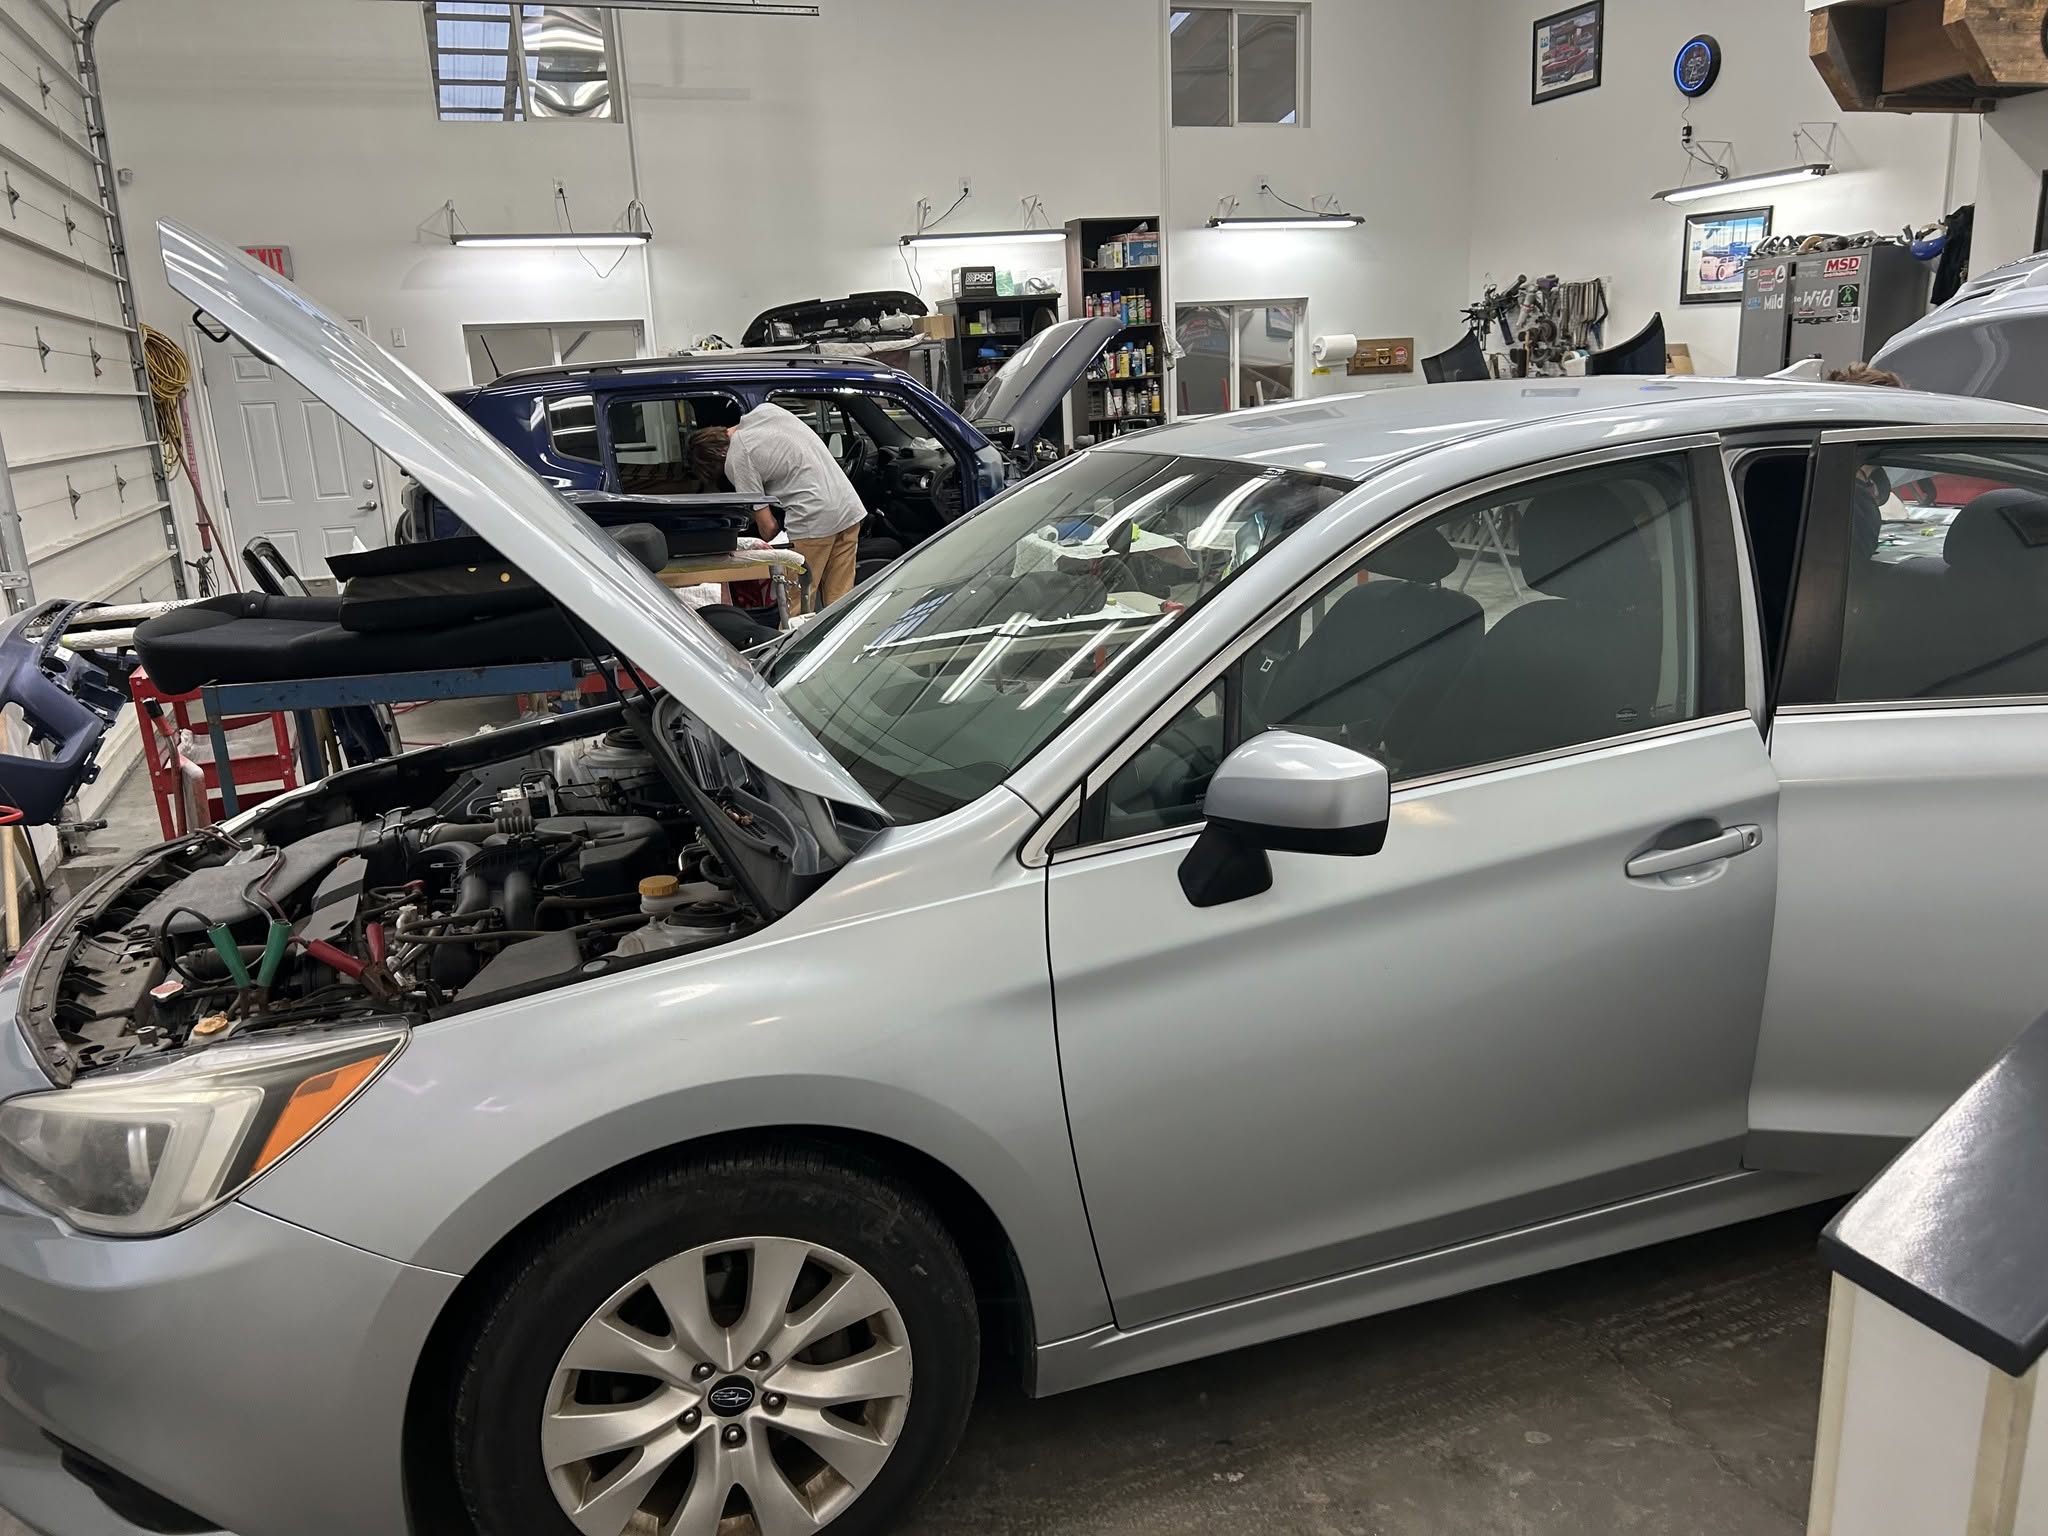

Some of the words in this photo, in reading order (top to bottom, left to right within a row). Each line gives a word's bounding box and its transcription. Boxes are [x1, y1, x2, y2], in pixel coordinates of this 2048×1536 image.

[246, 248, 284, 276] XIT
[1826, 258, 1859, 271] MSD
[973, 273, 992, 282] PSC
[1763, 293, 1784, 310] Mild
[1793, 295, 1802, 303] to
[1802, 288, 1834, 307] Wild
